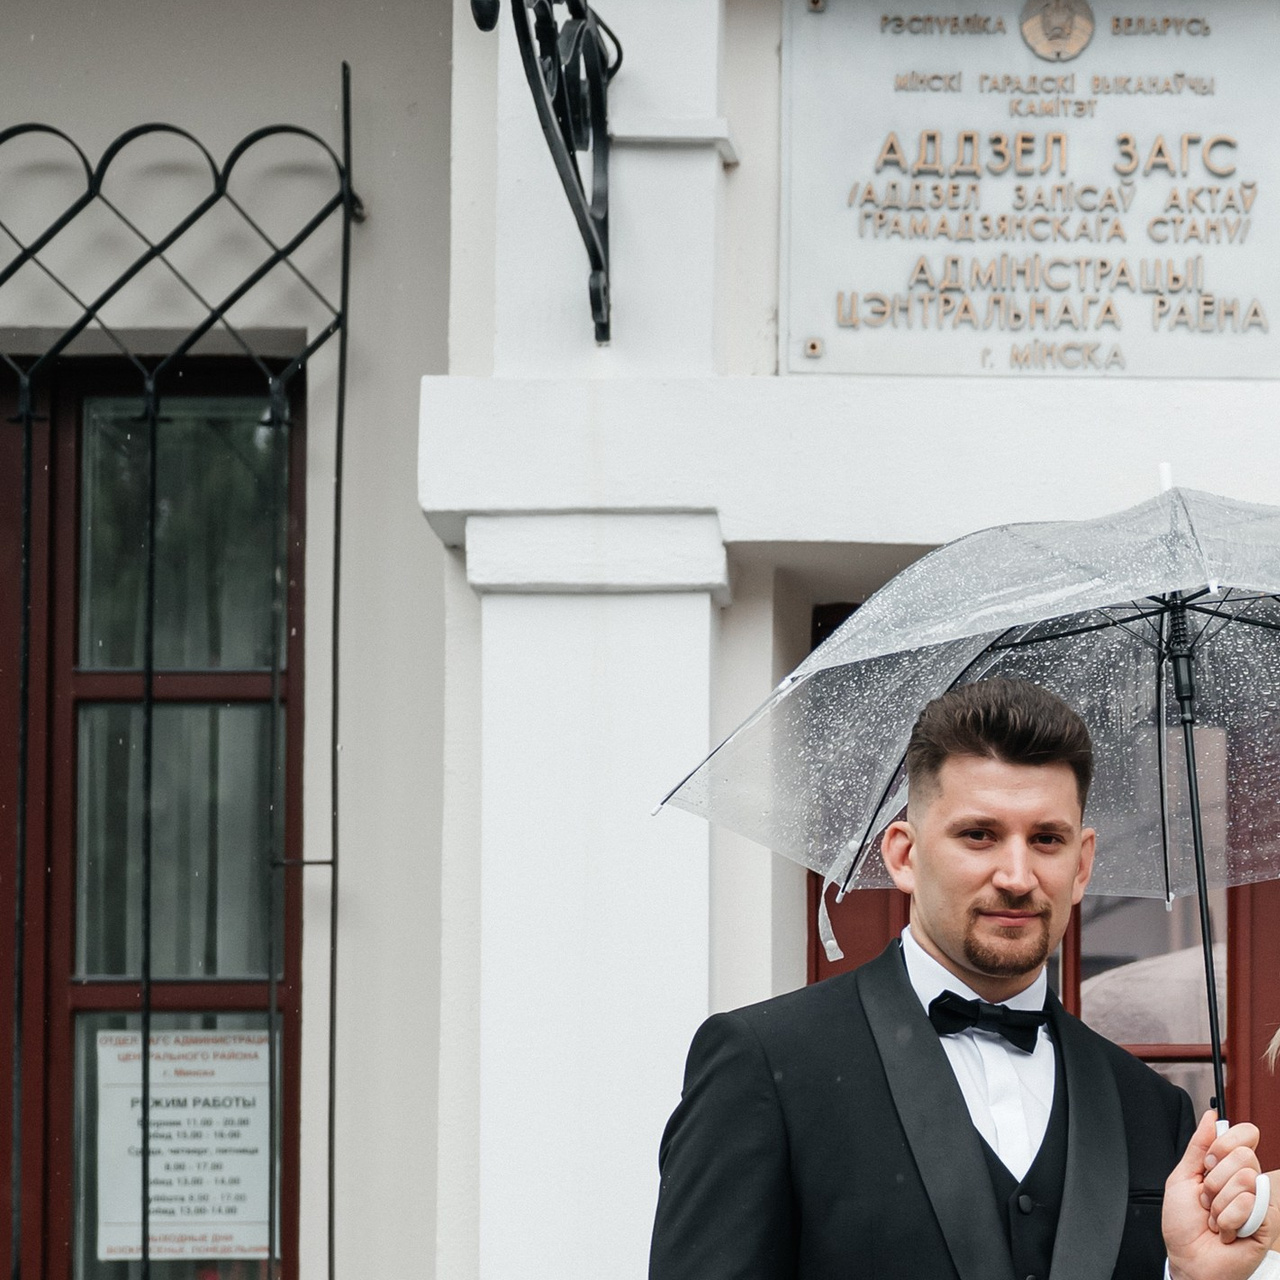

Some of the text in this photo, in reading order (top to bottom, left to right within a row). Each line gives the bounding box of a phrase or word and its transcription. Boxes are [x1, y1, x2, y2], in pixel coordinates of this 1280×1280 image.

[880, 13, 1211, 37] РЭСПУБЛІКА БЕЛАРУСЬ
[894, 70, 1215, 96] МІНСКІ ГАРАДСКІ ВЫКАНАЎЧЫ
[1009, 96, 1098, 118] КАМІТЭТ
[875, 130, 1238, 179] АДДЗЕЛ ЗАГС
[1012, 181, 1137, 212] ЗАПІСАЎ
[1163, 180, 1258, 213] АКТАЎ
[857, 211, 1127, 243] ГРАМАДЗЯНСКАГА
[908, 253, 1206, 293] АДМІНІСТРАЦЫІ
[835, 291, 1123, 331] ЦЭНТРАЛЬНАГА
[1009, 338, 1126, 370] МІНСКА
[117, 1051, 209, 1062] ЦЕНРАЛЬНОГО
[130, 1096, 256, 1109] РЖИМ РАБОТЫ
